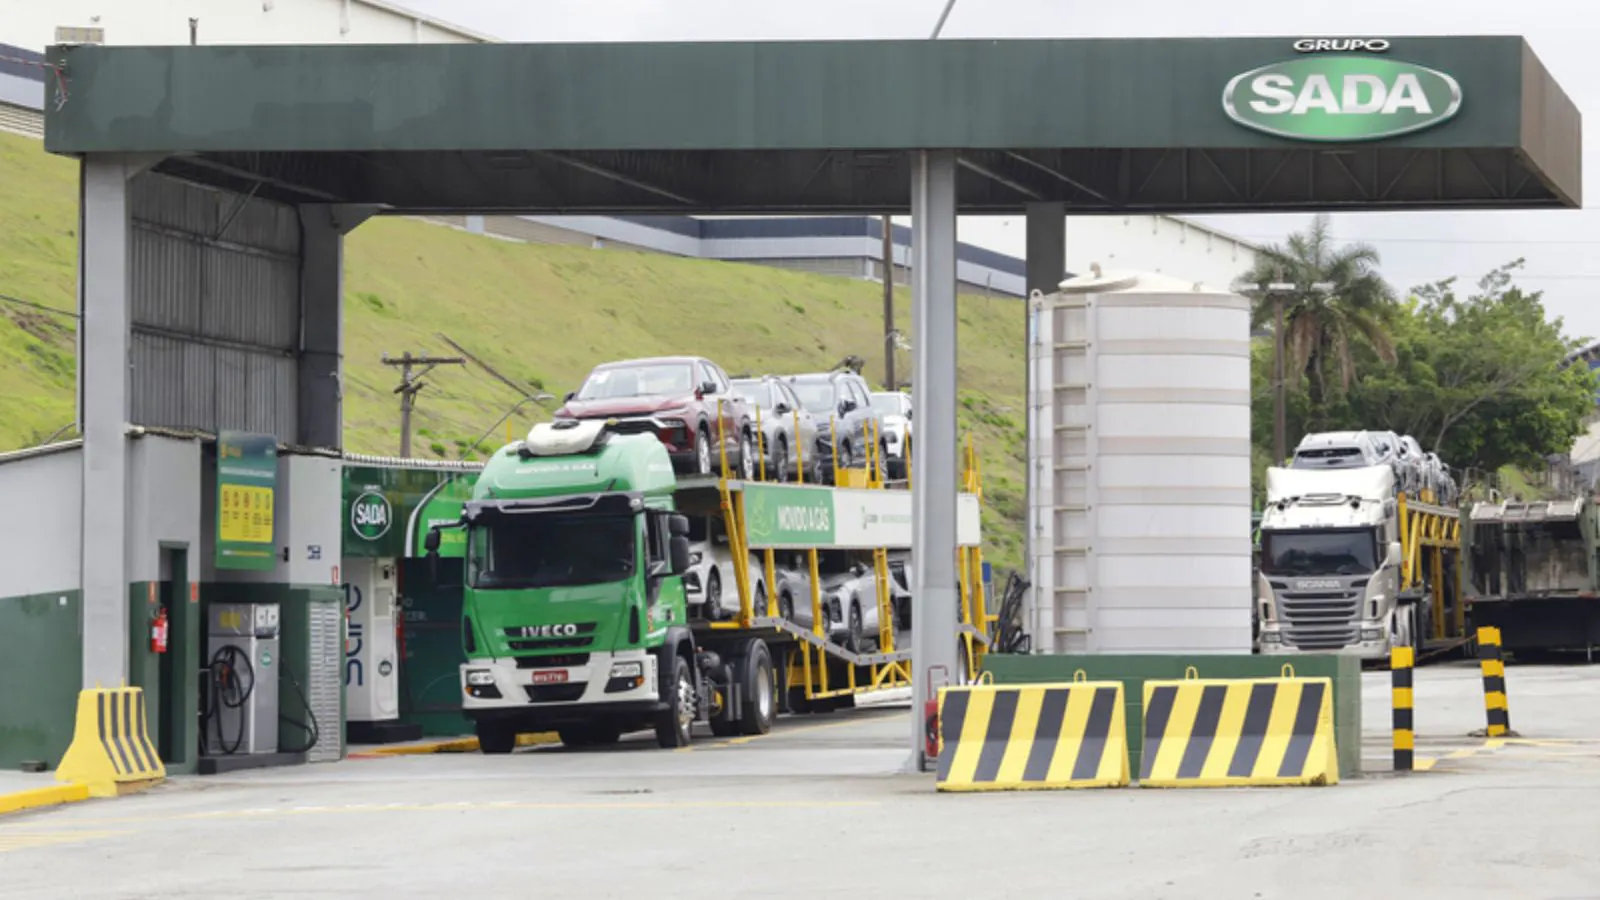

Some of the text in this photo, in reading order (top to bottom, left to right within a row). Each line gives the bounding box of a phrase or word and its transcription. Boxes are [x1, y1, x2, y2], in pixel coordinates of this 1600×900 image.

[1293, 38, 1390, 51] GRUPO
[1249, 73, 1433, 115] SADA
[356, 503, 387, 525] SADA
[1296, 580, 1341, 589] SCANIA
[521, 624, 577, 638] IVECO
